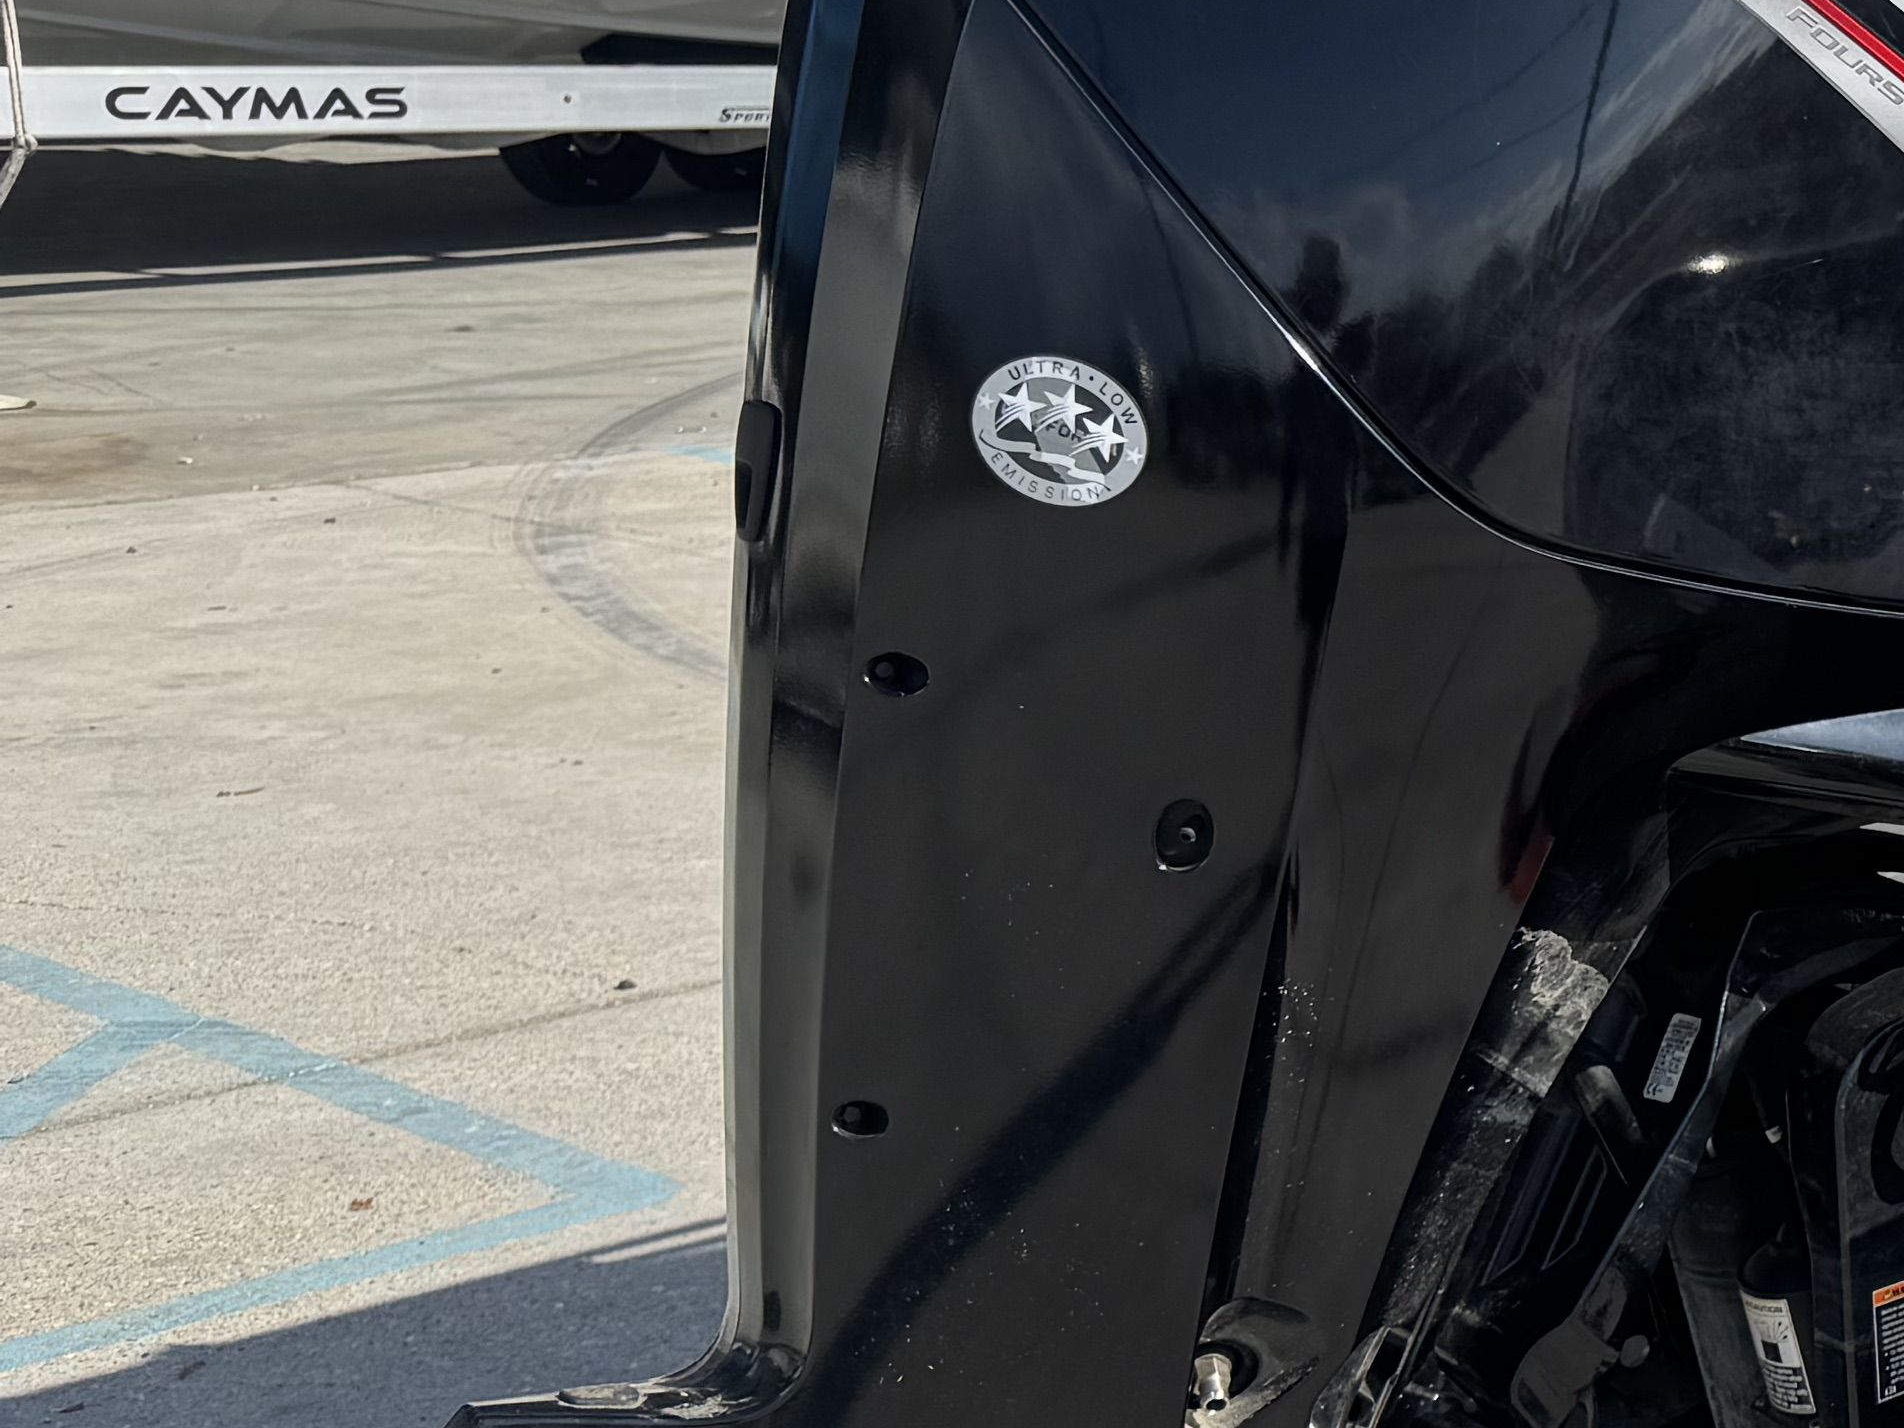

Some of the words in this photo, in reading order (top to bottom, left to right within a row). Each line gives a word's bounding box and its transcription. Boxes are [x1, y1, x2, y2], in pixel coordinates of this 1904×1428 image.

[103, 84, 409, 122] CAYMAS
[1008, 360, 1081, 381] ULTRA
[1099, 381, 1138, 426] LOW
[991, 453, 1101, 502] EMISSION
